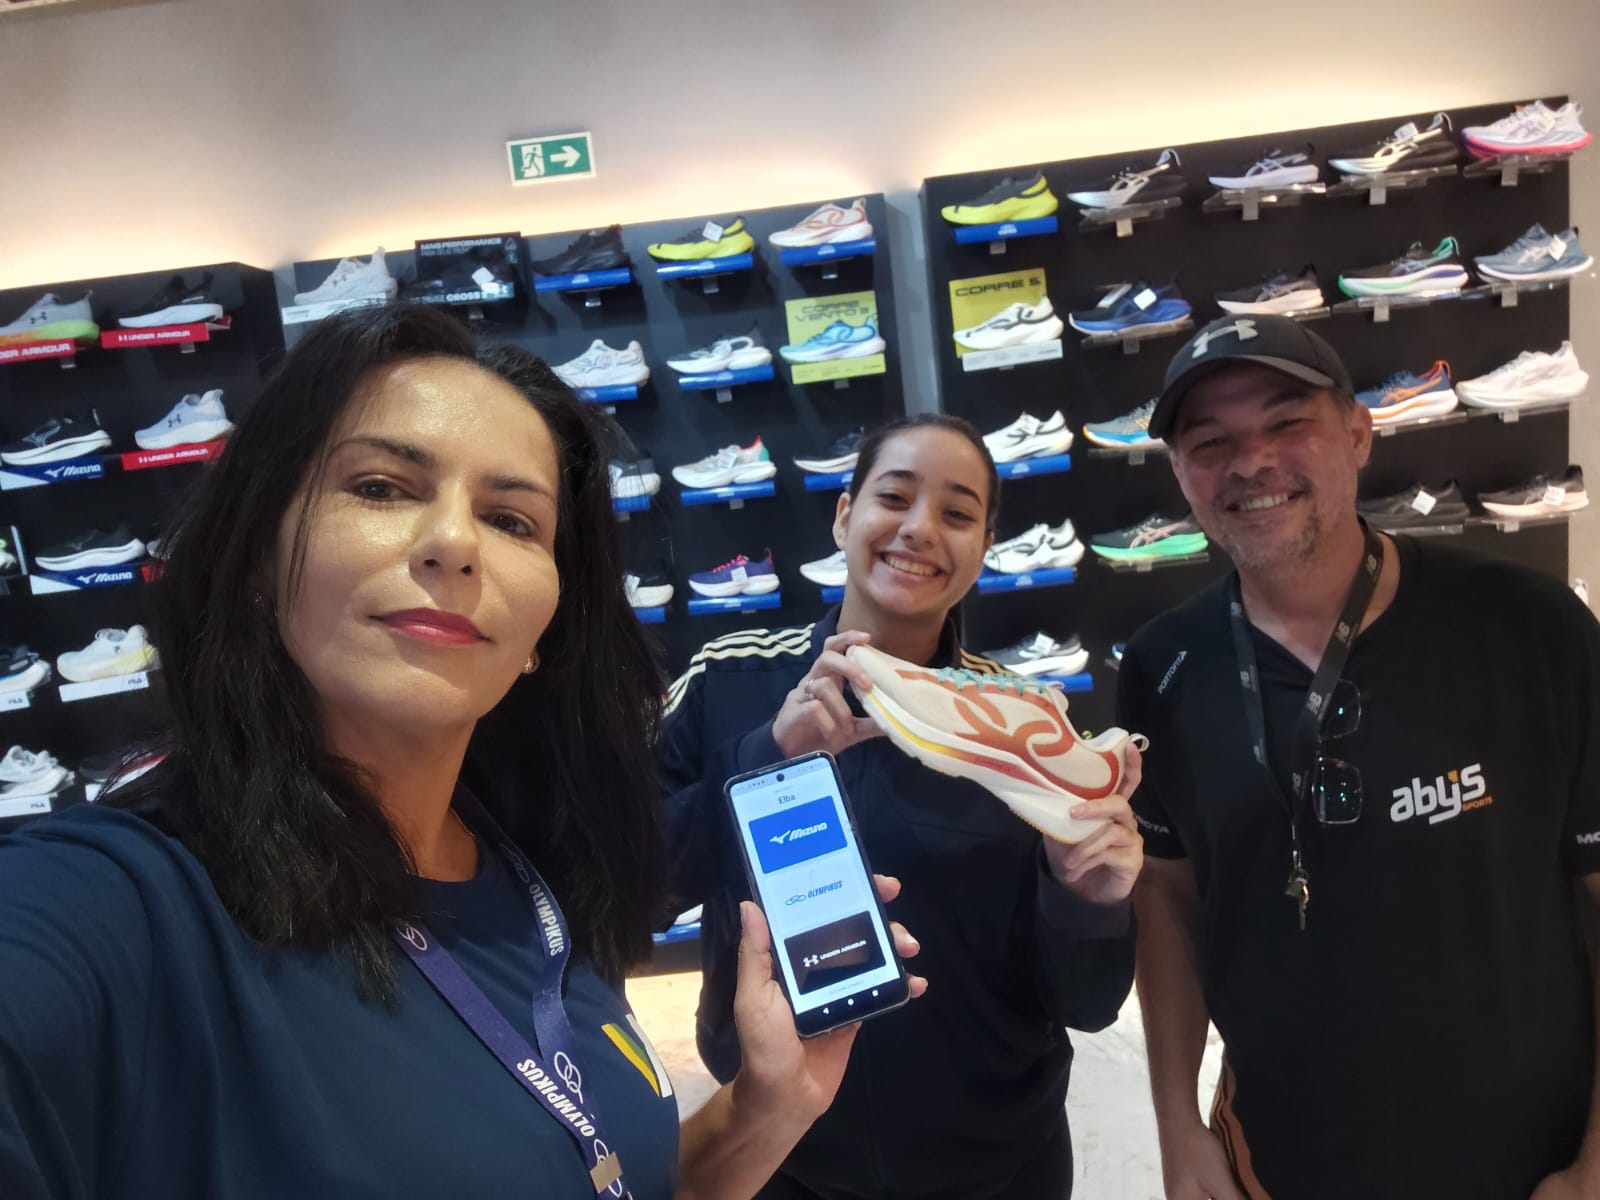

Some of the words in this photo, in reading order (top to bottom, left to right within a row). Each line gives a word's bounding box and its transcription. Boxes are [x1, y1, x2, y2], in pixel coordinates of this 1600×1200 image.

[128, 333, 155, 342] UNDER
[156, 330, 191, 339] ARMOUR
[21, 343, 71, 356] ARMOUR
[147, 453, 175, 462] UNDER
[175, 448, 209, 458] ARMOUR
[778, 794, 797, 805] Elba
[807, 880, 843, 899] OLYMPIKUS
[529, 883, 565, 957] OLYMPIKUS
[819, 949, 841, 960] UNDER
[840, 940, 867, 953] ARMOUR
[516, 1058, 596, 1137] OLYMPIKUS
